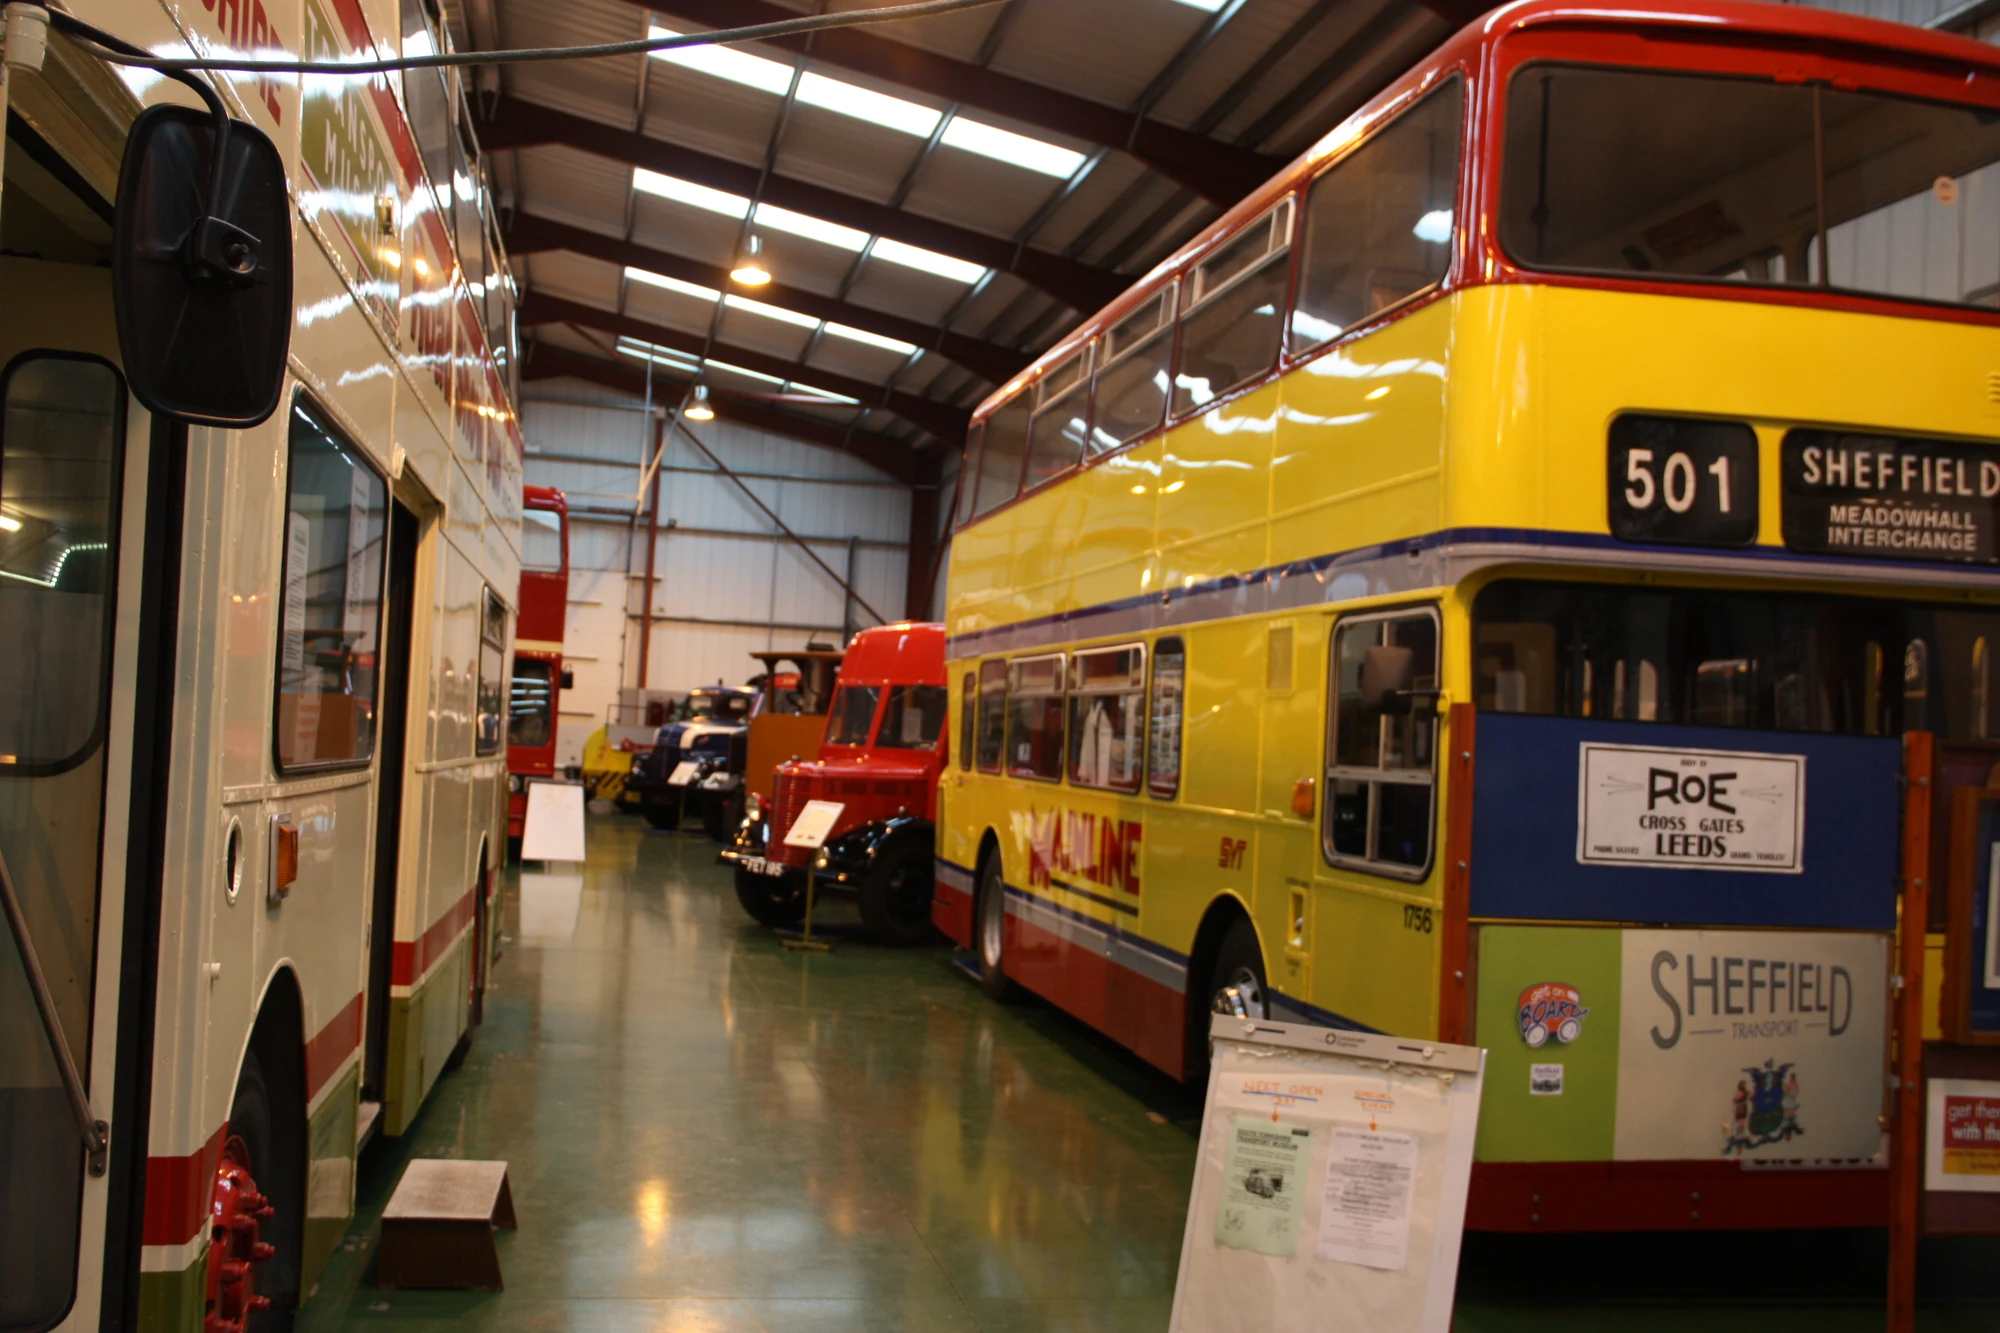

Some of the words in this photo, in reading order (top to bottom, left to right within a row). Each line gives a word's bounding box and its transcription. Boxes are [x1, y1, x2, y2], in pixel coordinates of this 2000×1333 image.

[200, 0, 282, 128] HIRE
[1624, 448, 1732, 514] 501
[1802, 446, 2000, 498] SHEFFIELD
[1829, 504, 1977, 531] MEADOWHALL
[1828, 526, 1977, 552] INTERCHANGE
[1648, 767, 1737, 815] ROE
[1639, 814, 1686, 831] CROSS
[1698, 818, 1745, 834] GATES
[1029, 805, 1143, 896] MAINLINE
[1218, 836, 1247, 871] SYT
[1655, 832, 1727, 858] LEEDS
[1403, 904, 1433, 933] 1756
[1650, 950, 1853, 1049] SHEFFIELD
[1731, 1019, 1799, 1039] TRANSPORT
[1243, 1081, 1281, 1093] NEXT
[1289, 1085, 1323, 1096] OPEN
[1948, 1104, 1972, 1123] get
[1952, 1121, 1982, 1140] with
